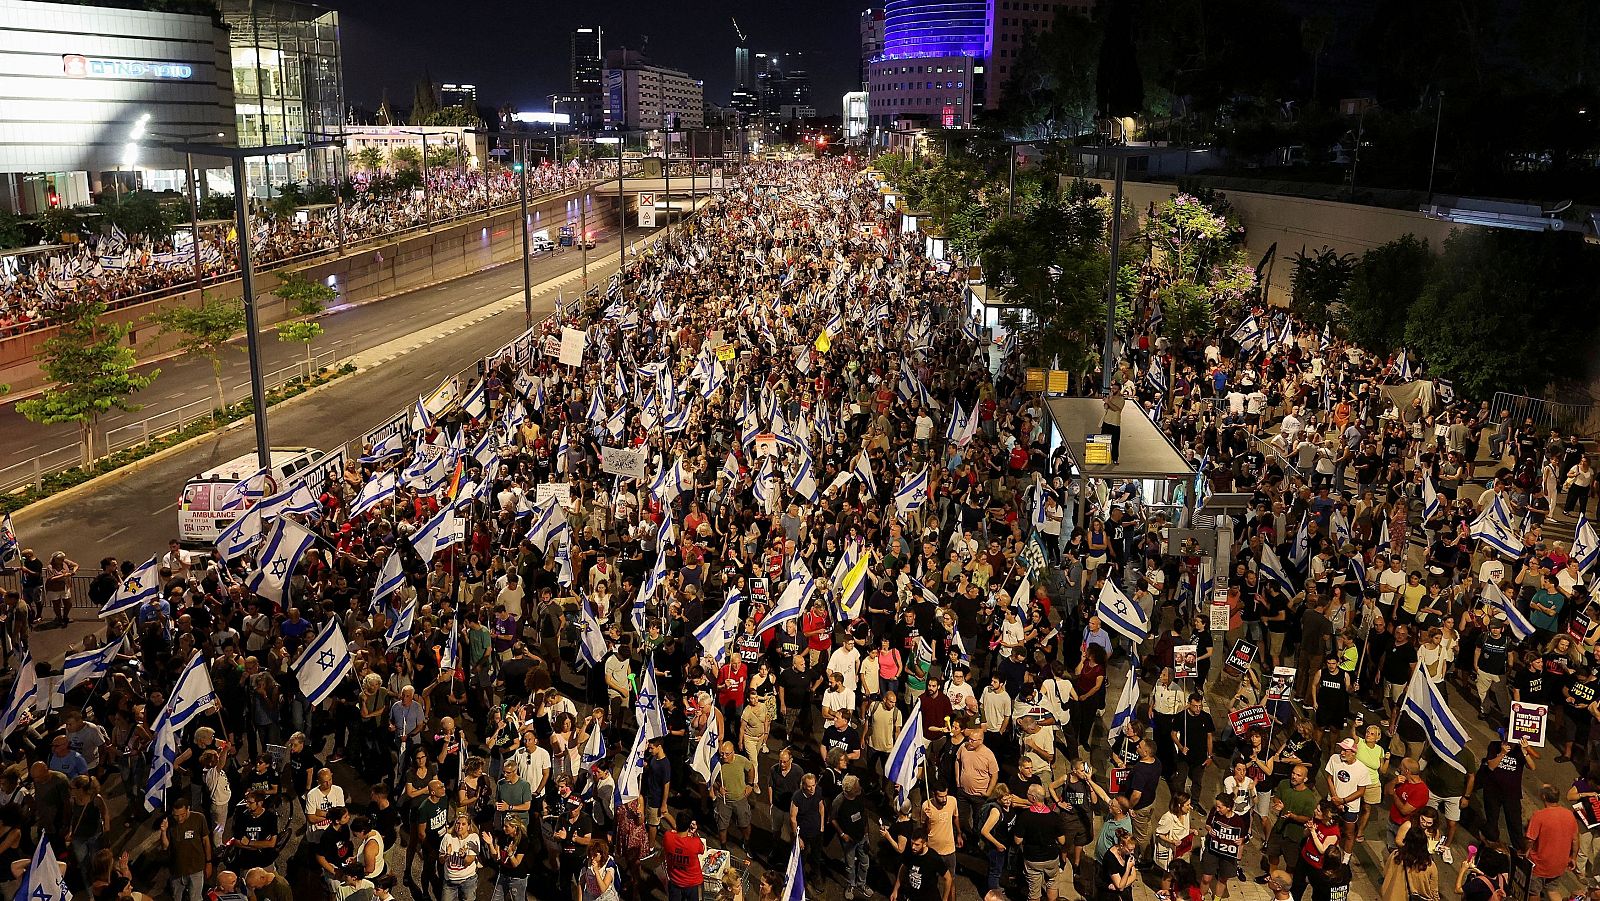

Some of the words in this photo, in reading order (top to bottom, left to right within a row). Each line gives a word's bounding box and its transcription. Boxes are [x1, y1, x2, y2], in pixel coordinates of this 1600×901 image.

[192, 511, 236, 519] AMBULANCE
[740, 650, 757, 660] 120
[1515, 719, 1540, 729] רעה
[1212, 840, 1237, 854] 120
